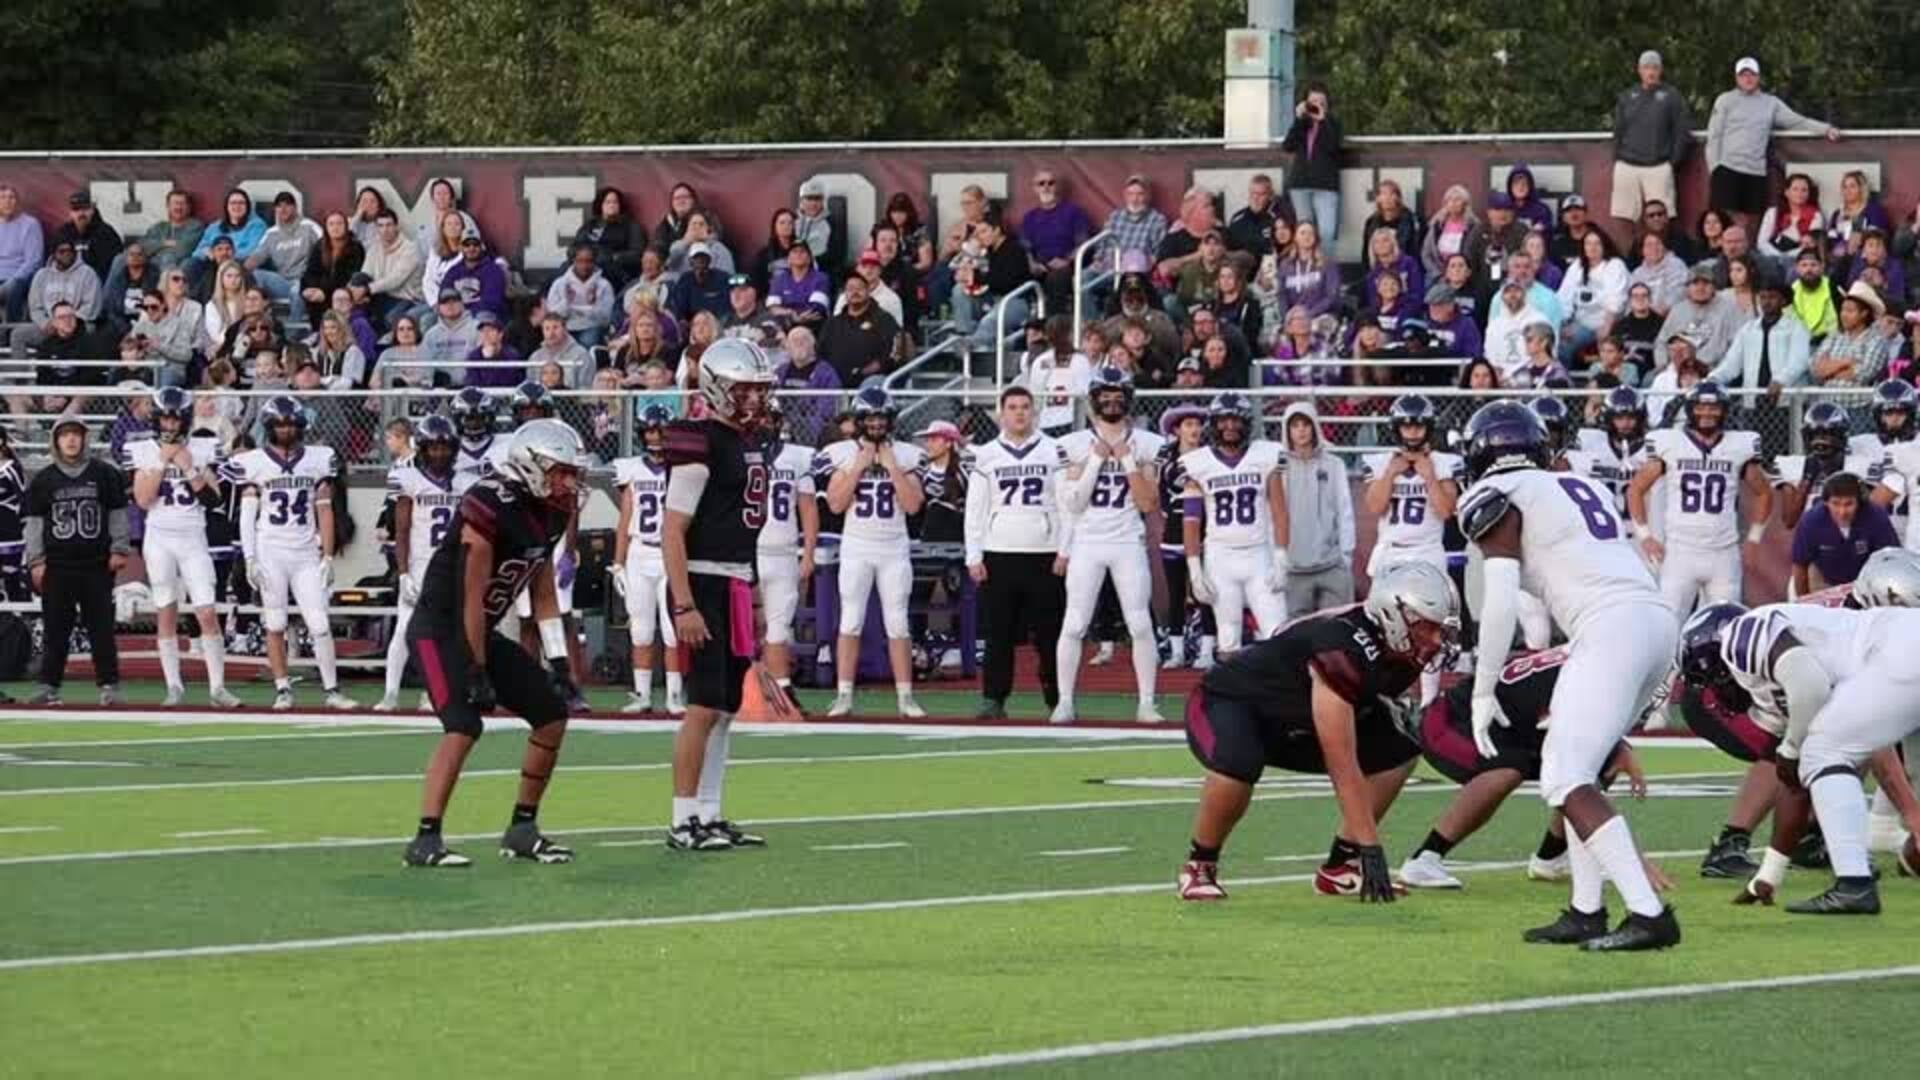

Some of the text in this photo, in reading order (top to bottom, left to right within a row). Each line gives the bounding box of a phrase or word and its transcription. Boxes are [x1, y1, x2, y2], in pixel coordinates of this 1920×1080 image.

[269, 489, 308, 526] 34
[743, 464, 768, 529] 9
[855, 481, 896, 518] 58
[999, 477, 1043, 506] 72
[1091, 475, 1130, 508] 67
[1214, 486, 1257, 526] 88
[1557, 477, 1618, 540] 8
[1681, 472, 1726, 514] 60
[52, 499, 101, 539] 50
[1389, 497, 1426, 525] 16
